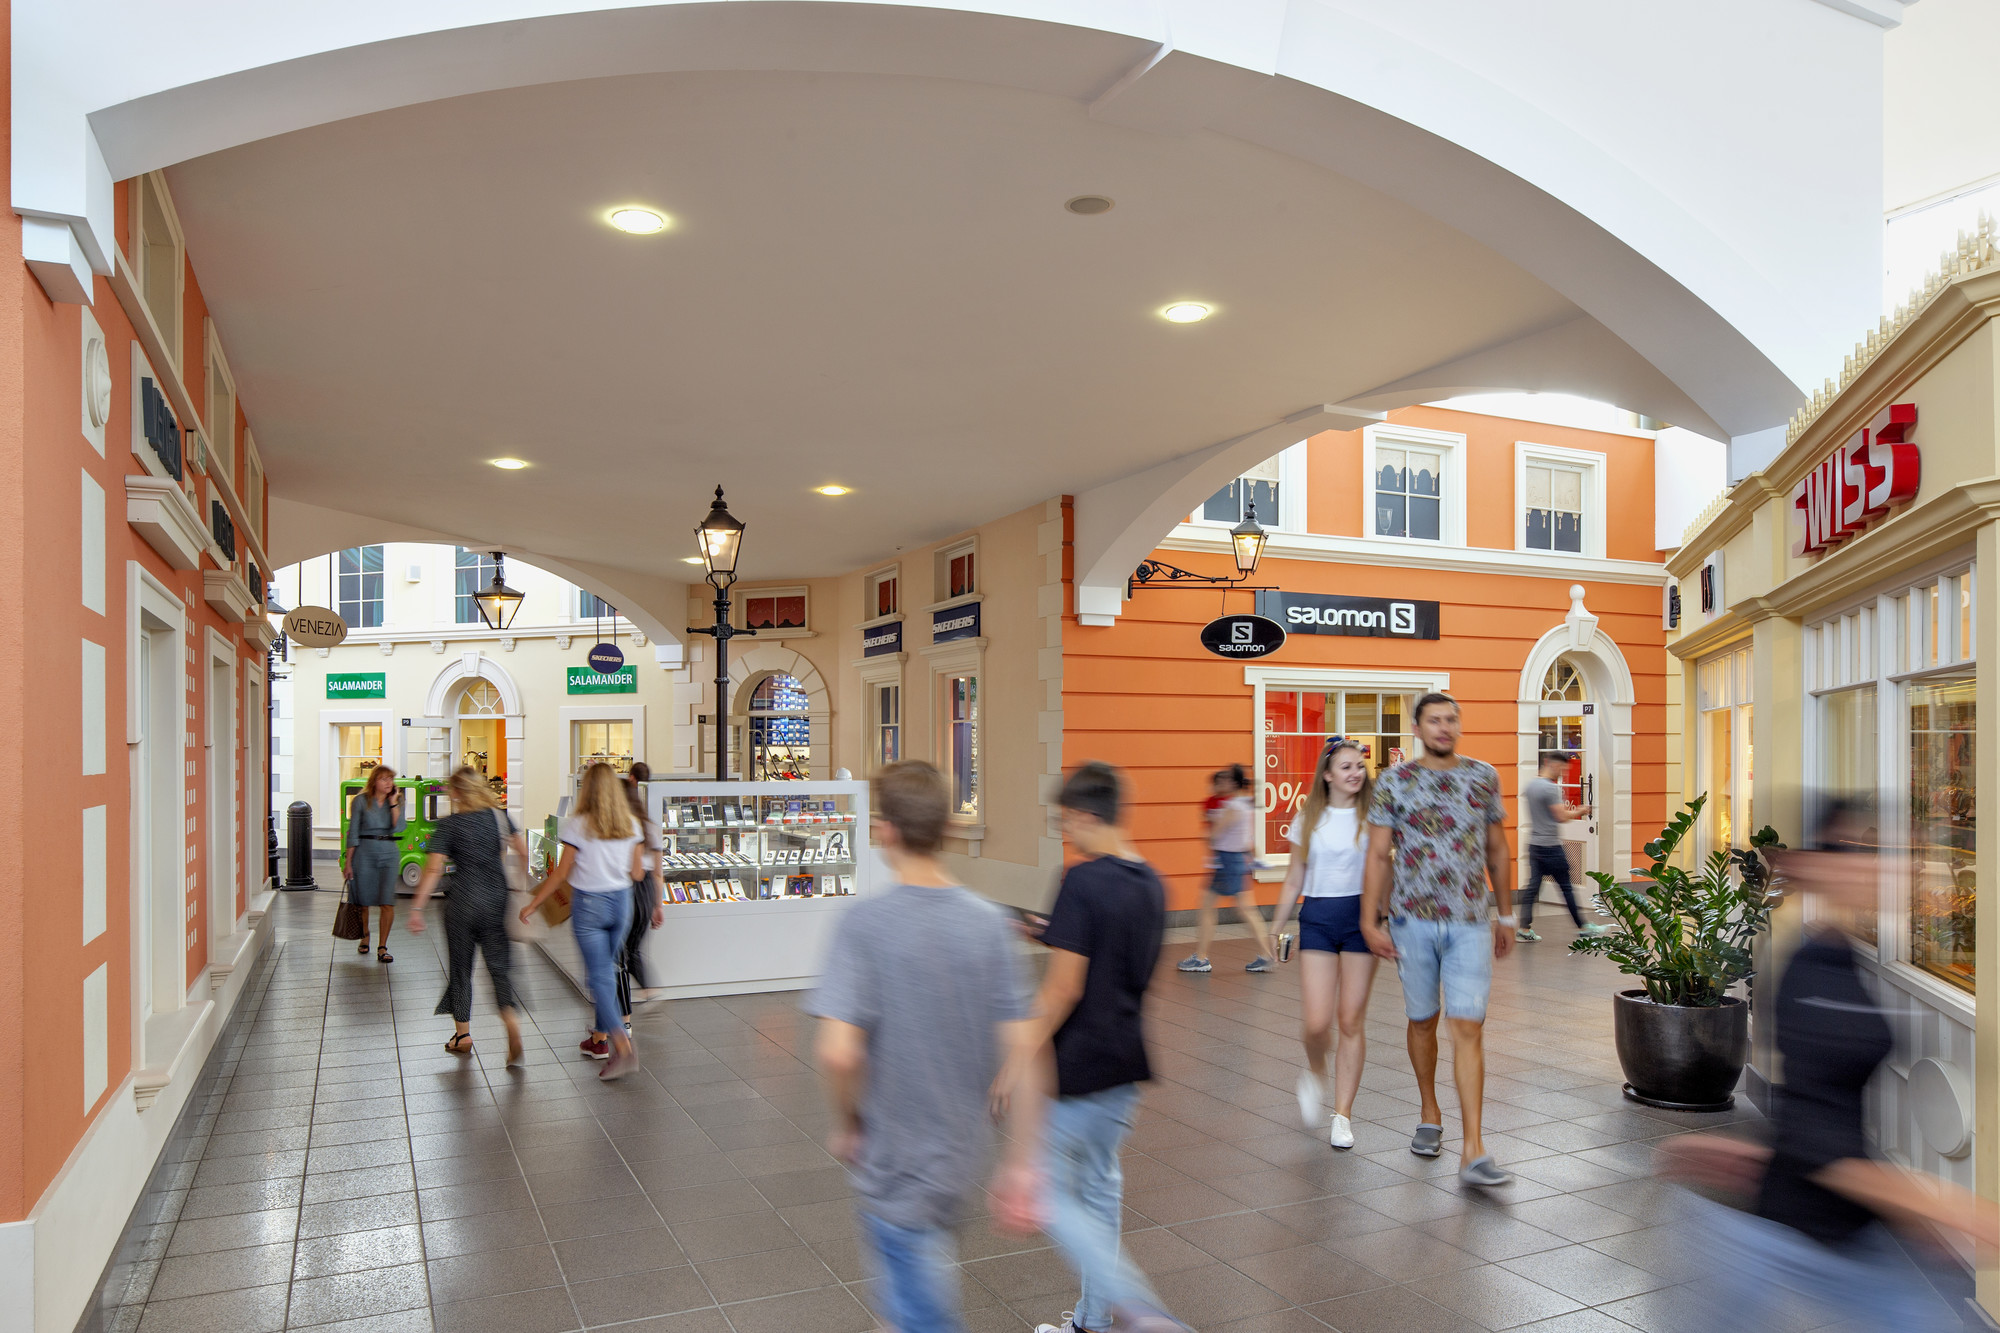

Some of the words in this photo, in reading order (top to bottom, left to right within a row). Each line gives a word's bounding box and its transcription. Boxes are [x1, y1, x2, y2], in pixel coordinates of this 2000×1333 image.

[1791, 403, 1919, 559] SWISS
[289, 617, 344, 638] VENEZIA
[932, 614, 976, 634] SKECHERS
[863, 632, 898, 649] SKECHERS
[328, 680, 383, 691] SALAMANDER
[569, 673, 633, 686] SALAMANDER
